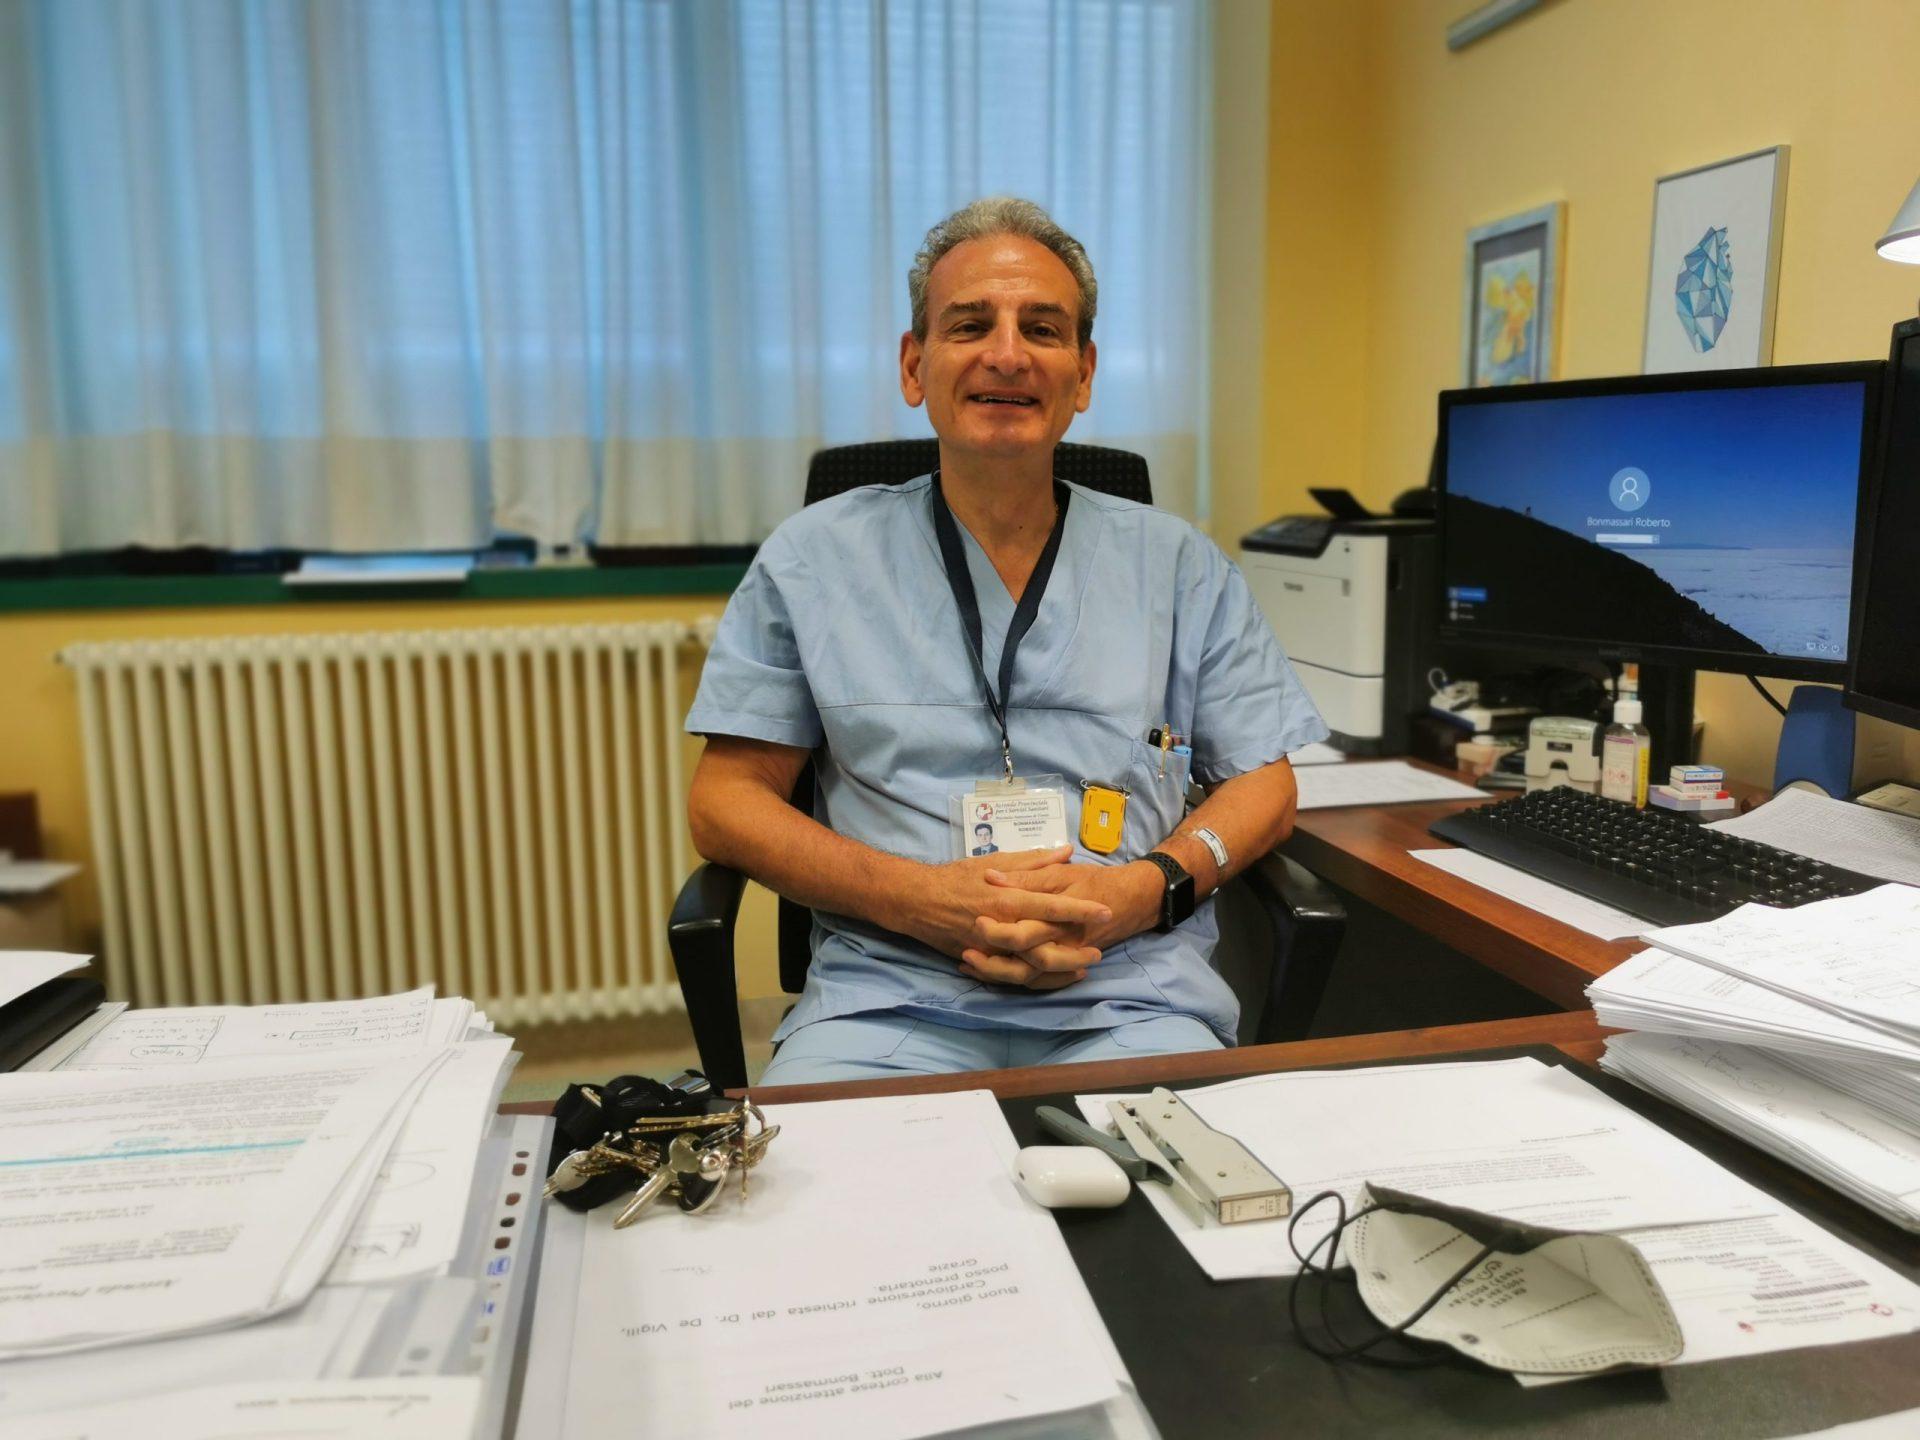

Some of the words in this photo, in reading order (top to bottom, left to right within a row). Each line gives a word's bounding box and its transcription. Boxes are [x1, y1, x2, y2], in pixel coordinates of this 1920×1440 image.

[1586, 516, 1633, 527] Bonmassari
[1635, 517, 1671, 528] Roberto
[928, 1258, 978, 1271] Grazie
[965, 1263, 1009, 1278] posso
[867, 1280, 986, 1305] Cardioversione
[979, 1286, 1019, 1299] Buon
[788, 1300, 856, 1315] richiesta
[916, 1294, 972, 1309] giorno,
[715, 1314, 739, 1322] Dr.
[752, 1310, 776, 1320] dal
[680, 1318, 702, 1327] De
[866, 1366, 904, 1377] Dott.
[915, 1371, 943, 1381] Alla
[765, 1374, 858, 1393] Bonmassari
[851, 1377, 909, 1392] cortese
[760, 1387, 845, 1405] attenzione
[729, 1399, 754, 1410] del
